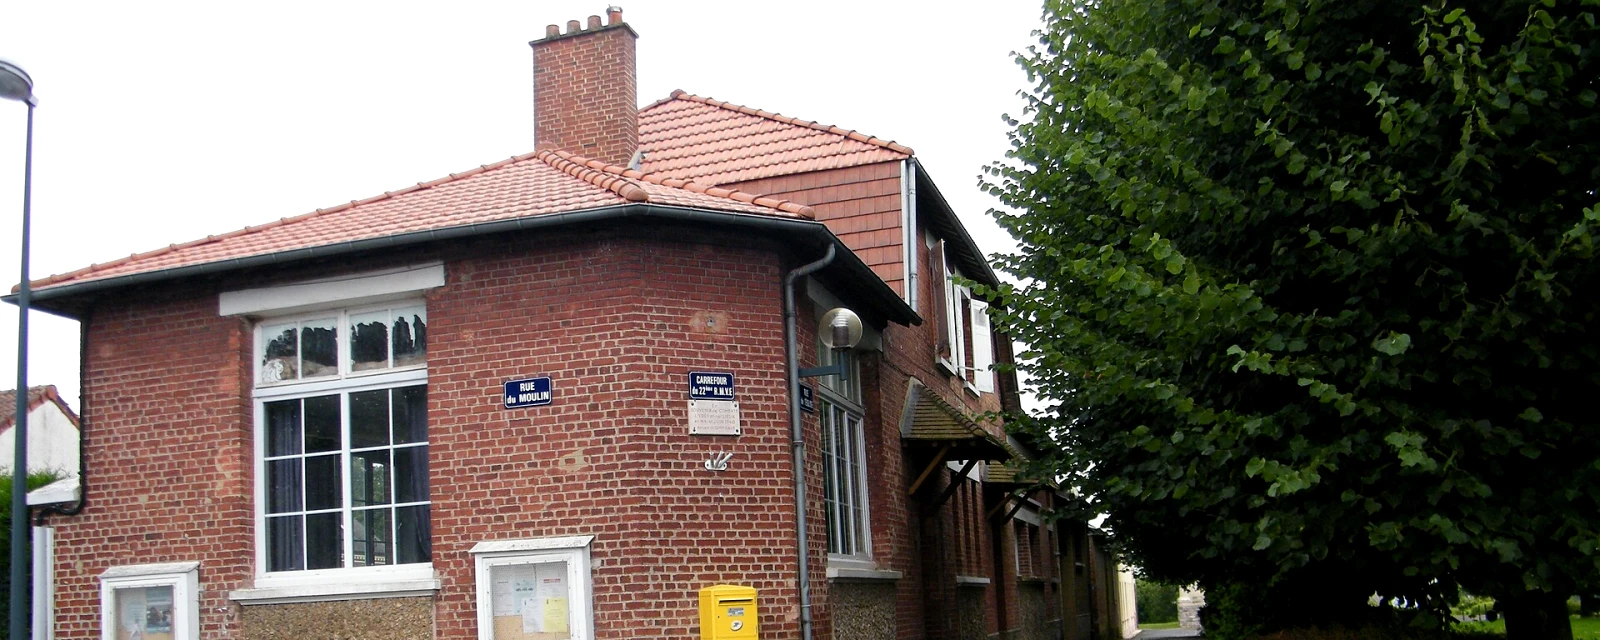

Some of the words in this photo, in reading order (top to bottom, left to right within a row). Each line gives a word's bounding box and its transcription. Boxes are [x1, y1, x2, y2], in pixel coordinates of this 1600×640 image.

[696, 375, 727, 385] CARREFOUR
[520, 382, 535, 392] RUE
[692, 385, 699, 395] du
[507, 395, 516, 404] du
[519, 391, 549, 403] MOULIN
